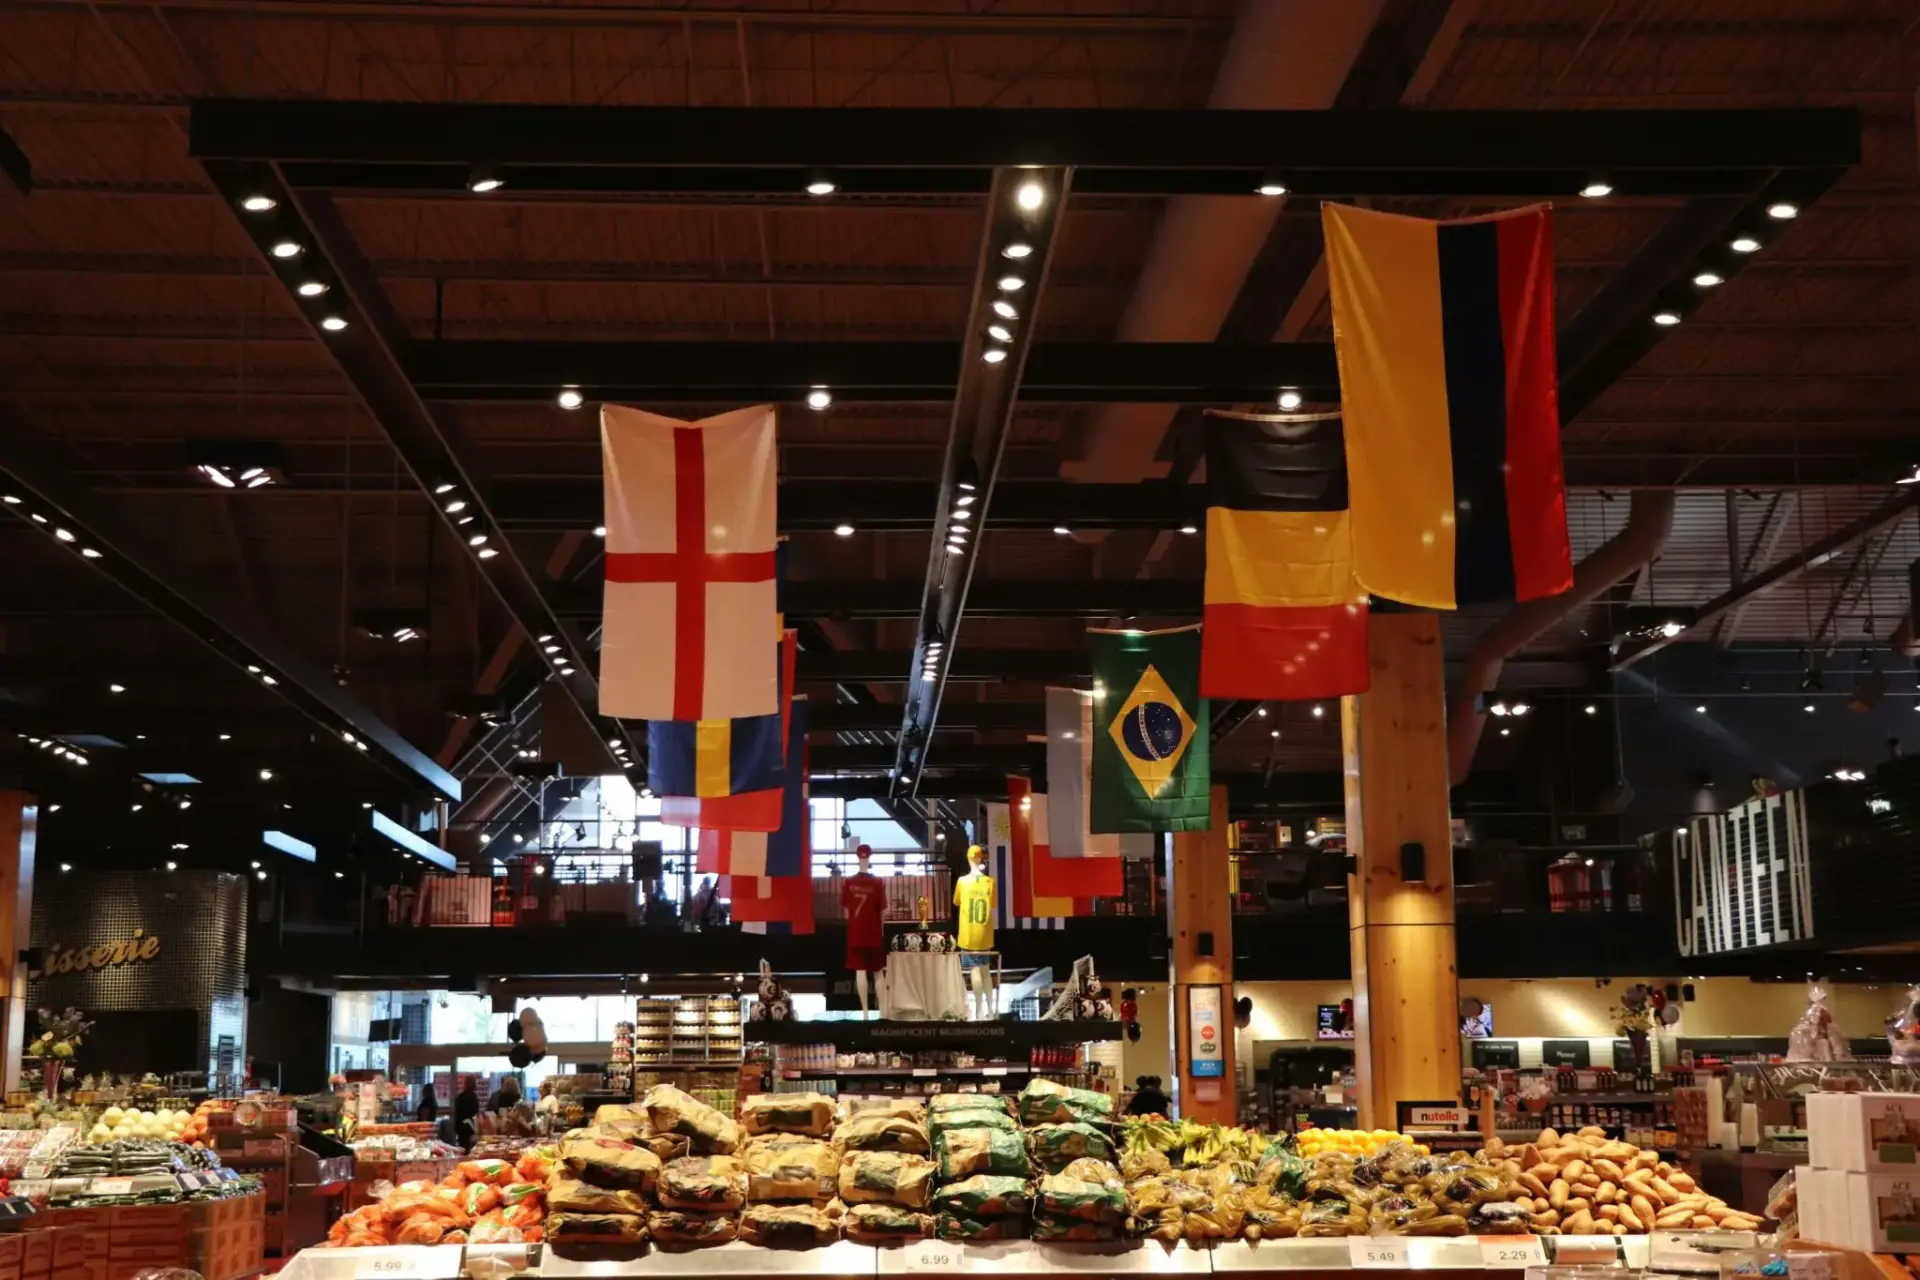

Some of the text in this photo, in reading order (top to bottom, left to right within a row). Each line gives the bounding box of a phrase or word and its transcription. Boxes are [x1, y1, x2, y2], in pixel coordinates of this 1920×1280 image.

[1672, 788, 1815, 958] CANTEEN
[853, 893, 868, 918] 7
[968, 898, 988, 924] 10
[870, 1027, 1005, 1037] MAGNIFICENT MUSHROOMS
[1421, 1110, 1459, 1122] nutella
[920, 1255, 949, 1265] 6.99
[1367, 1252, 1395, 1262] 5.49
[1499, 1250, 1527, 1261] 2.29
